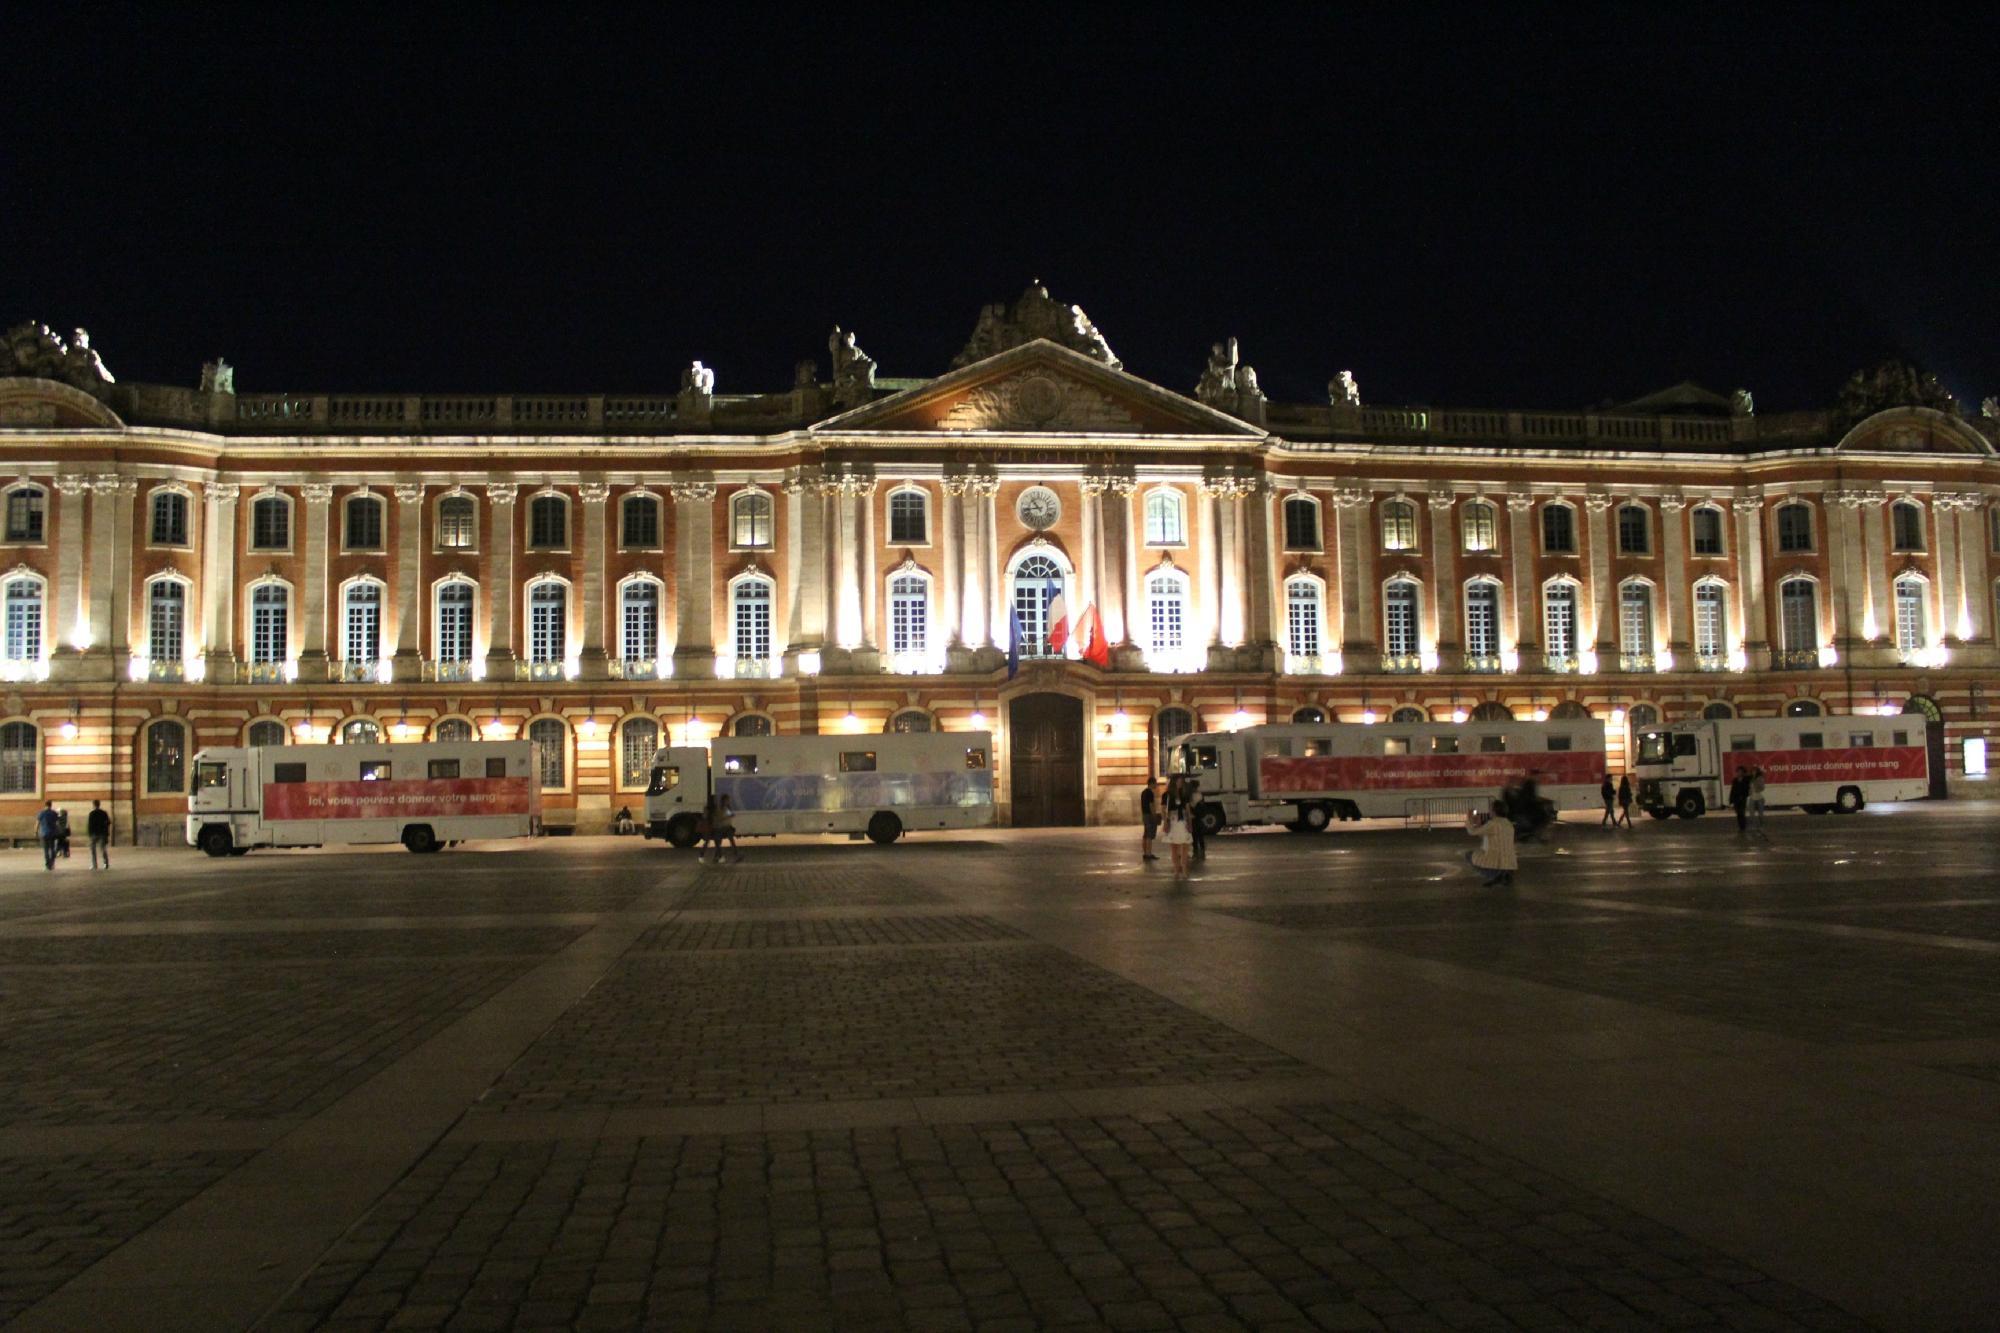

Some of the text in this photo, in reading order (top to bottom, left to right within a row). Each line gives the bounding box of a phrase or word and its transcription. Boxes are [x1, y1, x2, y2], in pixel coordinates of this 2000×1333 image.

[955, 450, 1116, 464] CAPITOLIUM
[1769, 764, 1790, 772] vous
[1791, 762, 1822, 772] pouvez
[1823, 761, 1853, 770] donner
[1855, 760, 1876, 769] votre
[1878, 759, 1899, 769] sang
[1407, 769, 1441, 779] pouvez
[1443, 768, 1476, 777] donner
[1477, 768, 1501, 776] votre
[1503, 767, 1526, 776] sang
[327, 797, 353, 806] vous
[356, 796, 395, 806] pouvez
[398, 794, 437, 804] donner
[439, 794, 466, 803] votre
[469, 794, 497, 803] sang
